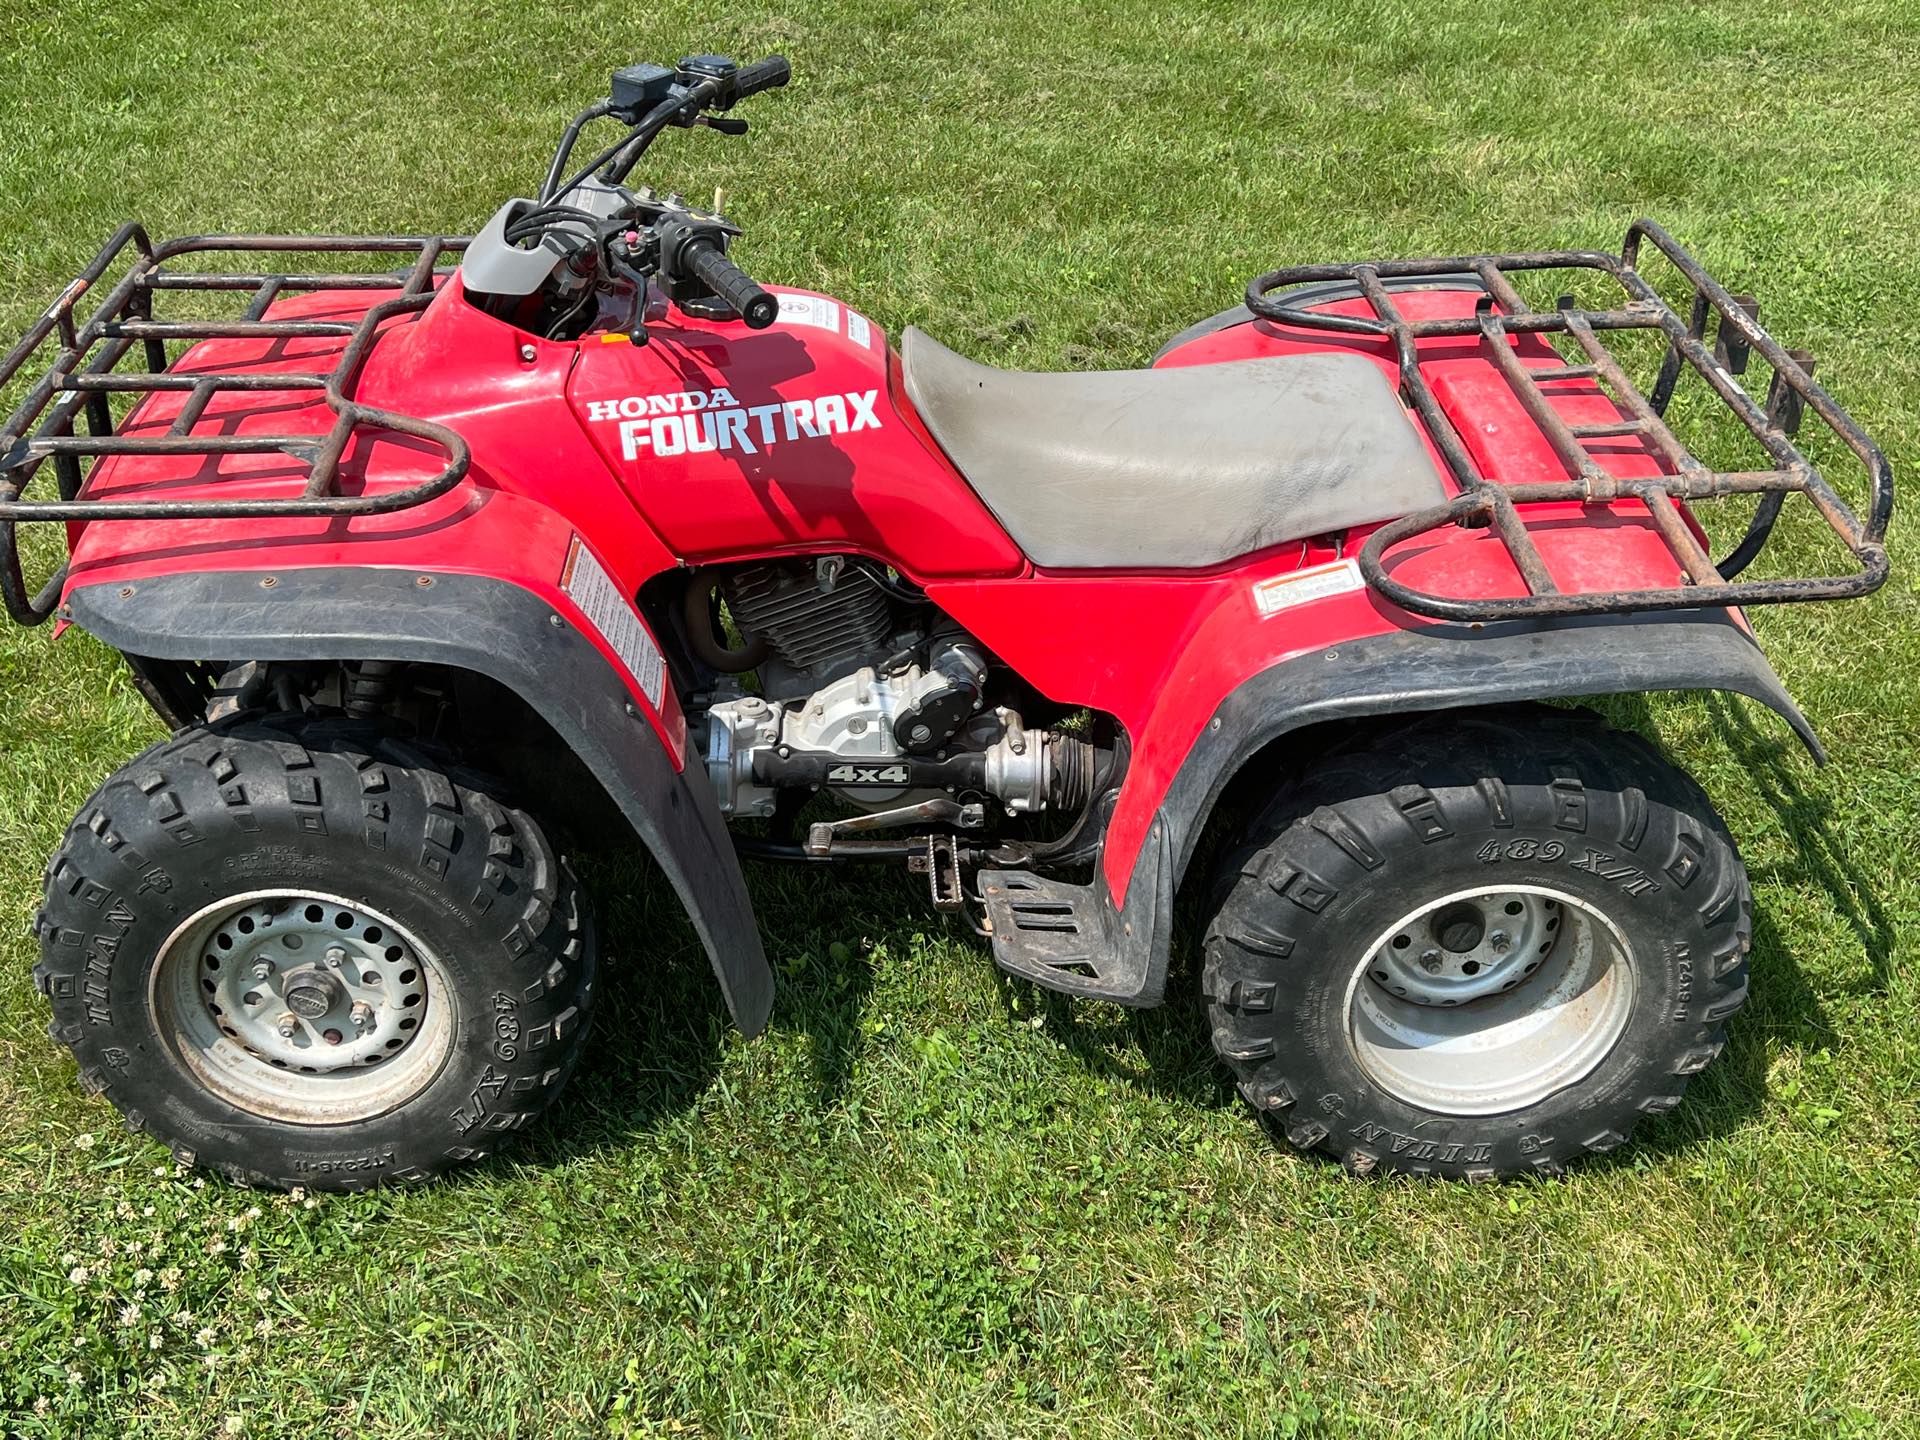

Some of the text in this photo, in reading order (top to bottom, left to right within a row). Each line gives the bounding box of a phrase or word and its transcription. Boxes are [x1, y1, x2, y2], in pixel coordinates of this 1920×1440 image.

[586, 387, 740, 422] HONDA
[618, 389, 883, 462] FOURTRAX
[829, 765, 907, 783] 4x4
[1477, 837, 1566, 865] 489
[1569, 847, 1662, 897] X/T
[83, 896, 137, 1026] TITAN
[450, 990, 521, 1137] 489 X/T
[1348, 1120, 1493, 1164] TITAN
